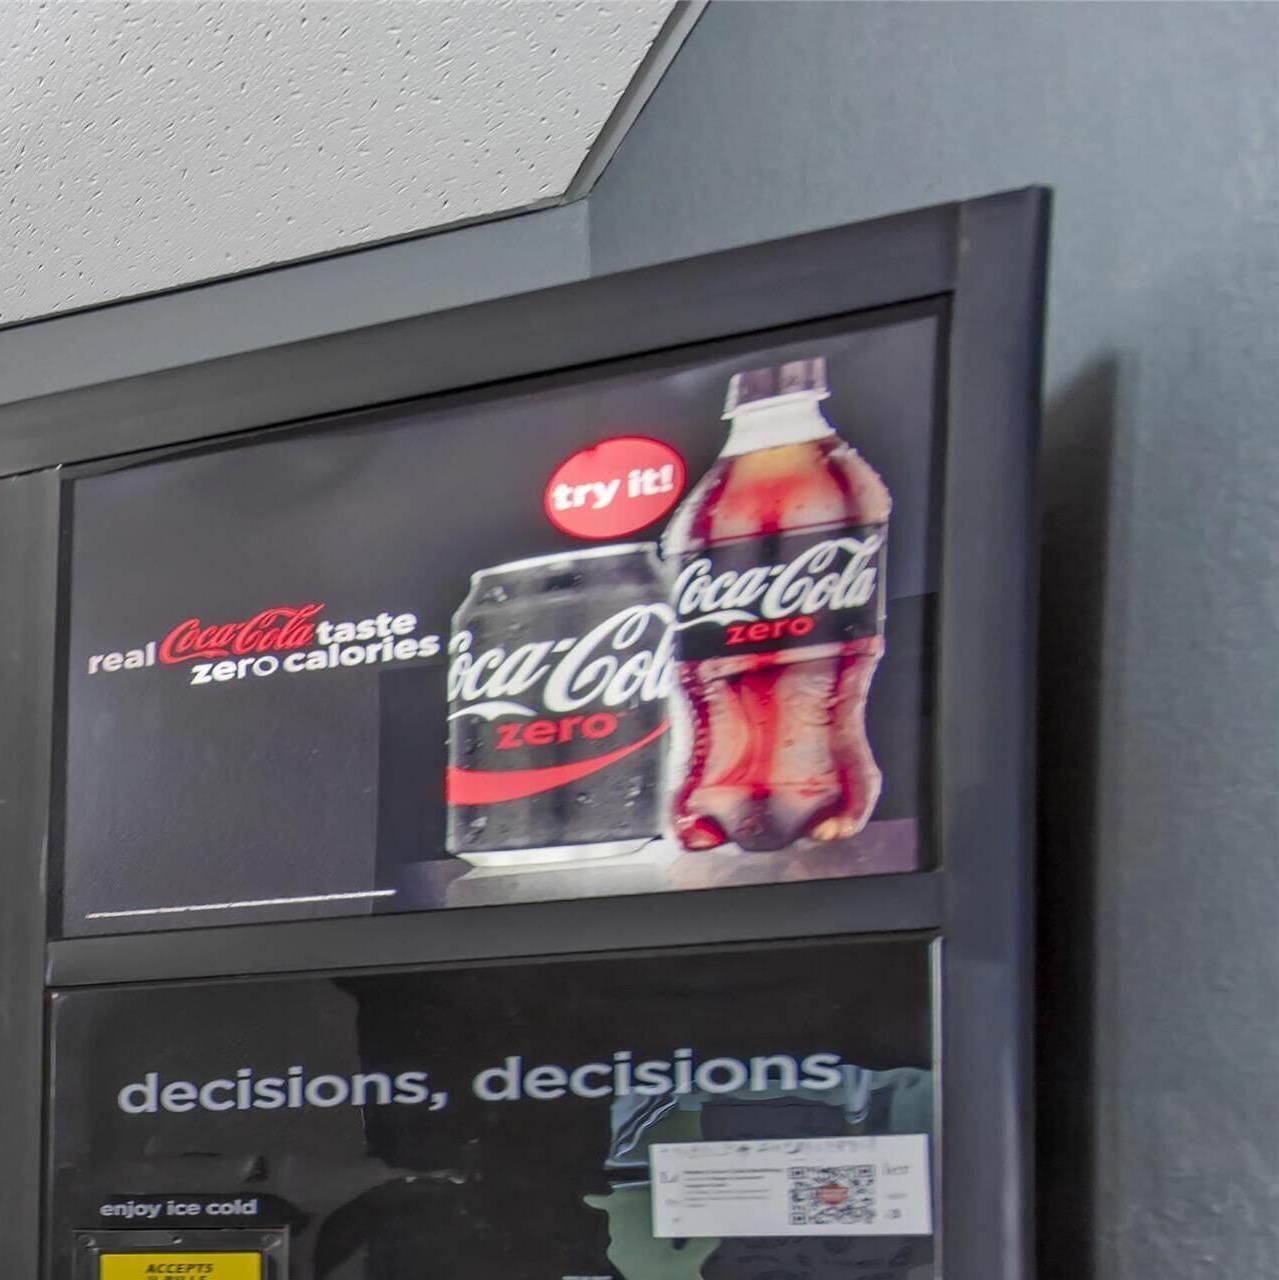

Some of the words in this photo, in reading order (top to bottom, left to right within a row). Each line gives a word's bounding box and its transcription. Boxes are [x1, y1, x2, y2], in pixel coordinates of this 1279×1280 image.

[552, 478, 622, 511] try
[627, 464, 674, 498] it!
[674, 534, 884, 620] Coca-Cola
[87, 641, 156, 675] real
[159, 603, 326, 665] Coca-Cola
[316, 612, 418, 646] taste
[725, 615, 815, 646] zero
[190, 655, 279, 686] zero
[283, 632, 441, 673] calories
[495, 712, 618, 750] zero
[117, 1065, 449, 1115] decisions,
[473, 1047, 843, 1103] decisions
[99, 1201, 162, 1218] enjoy
[166, 1200, 202, 1215] ice
[205, 1199, 259, 1215] cold
[146, 1263, 214, 1273] ACCEPTS
